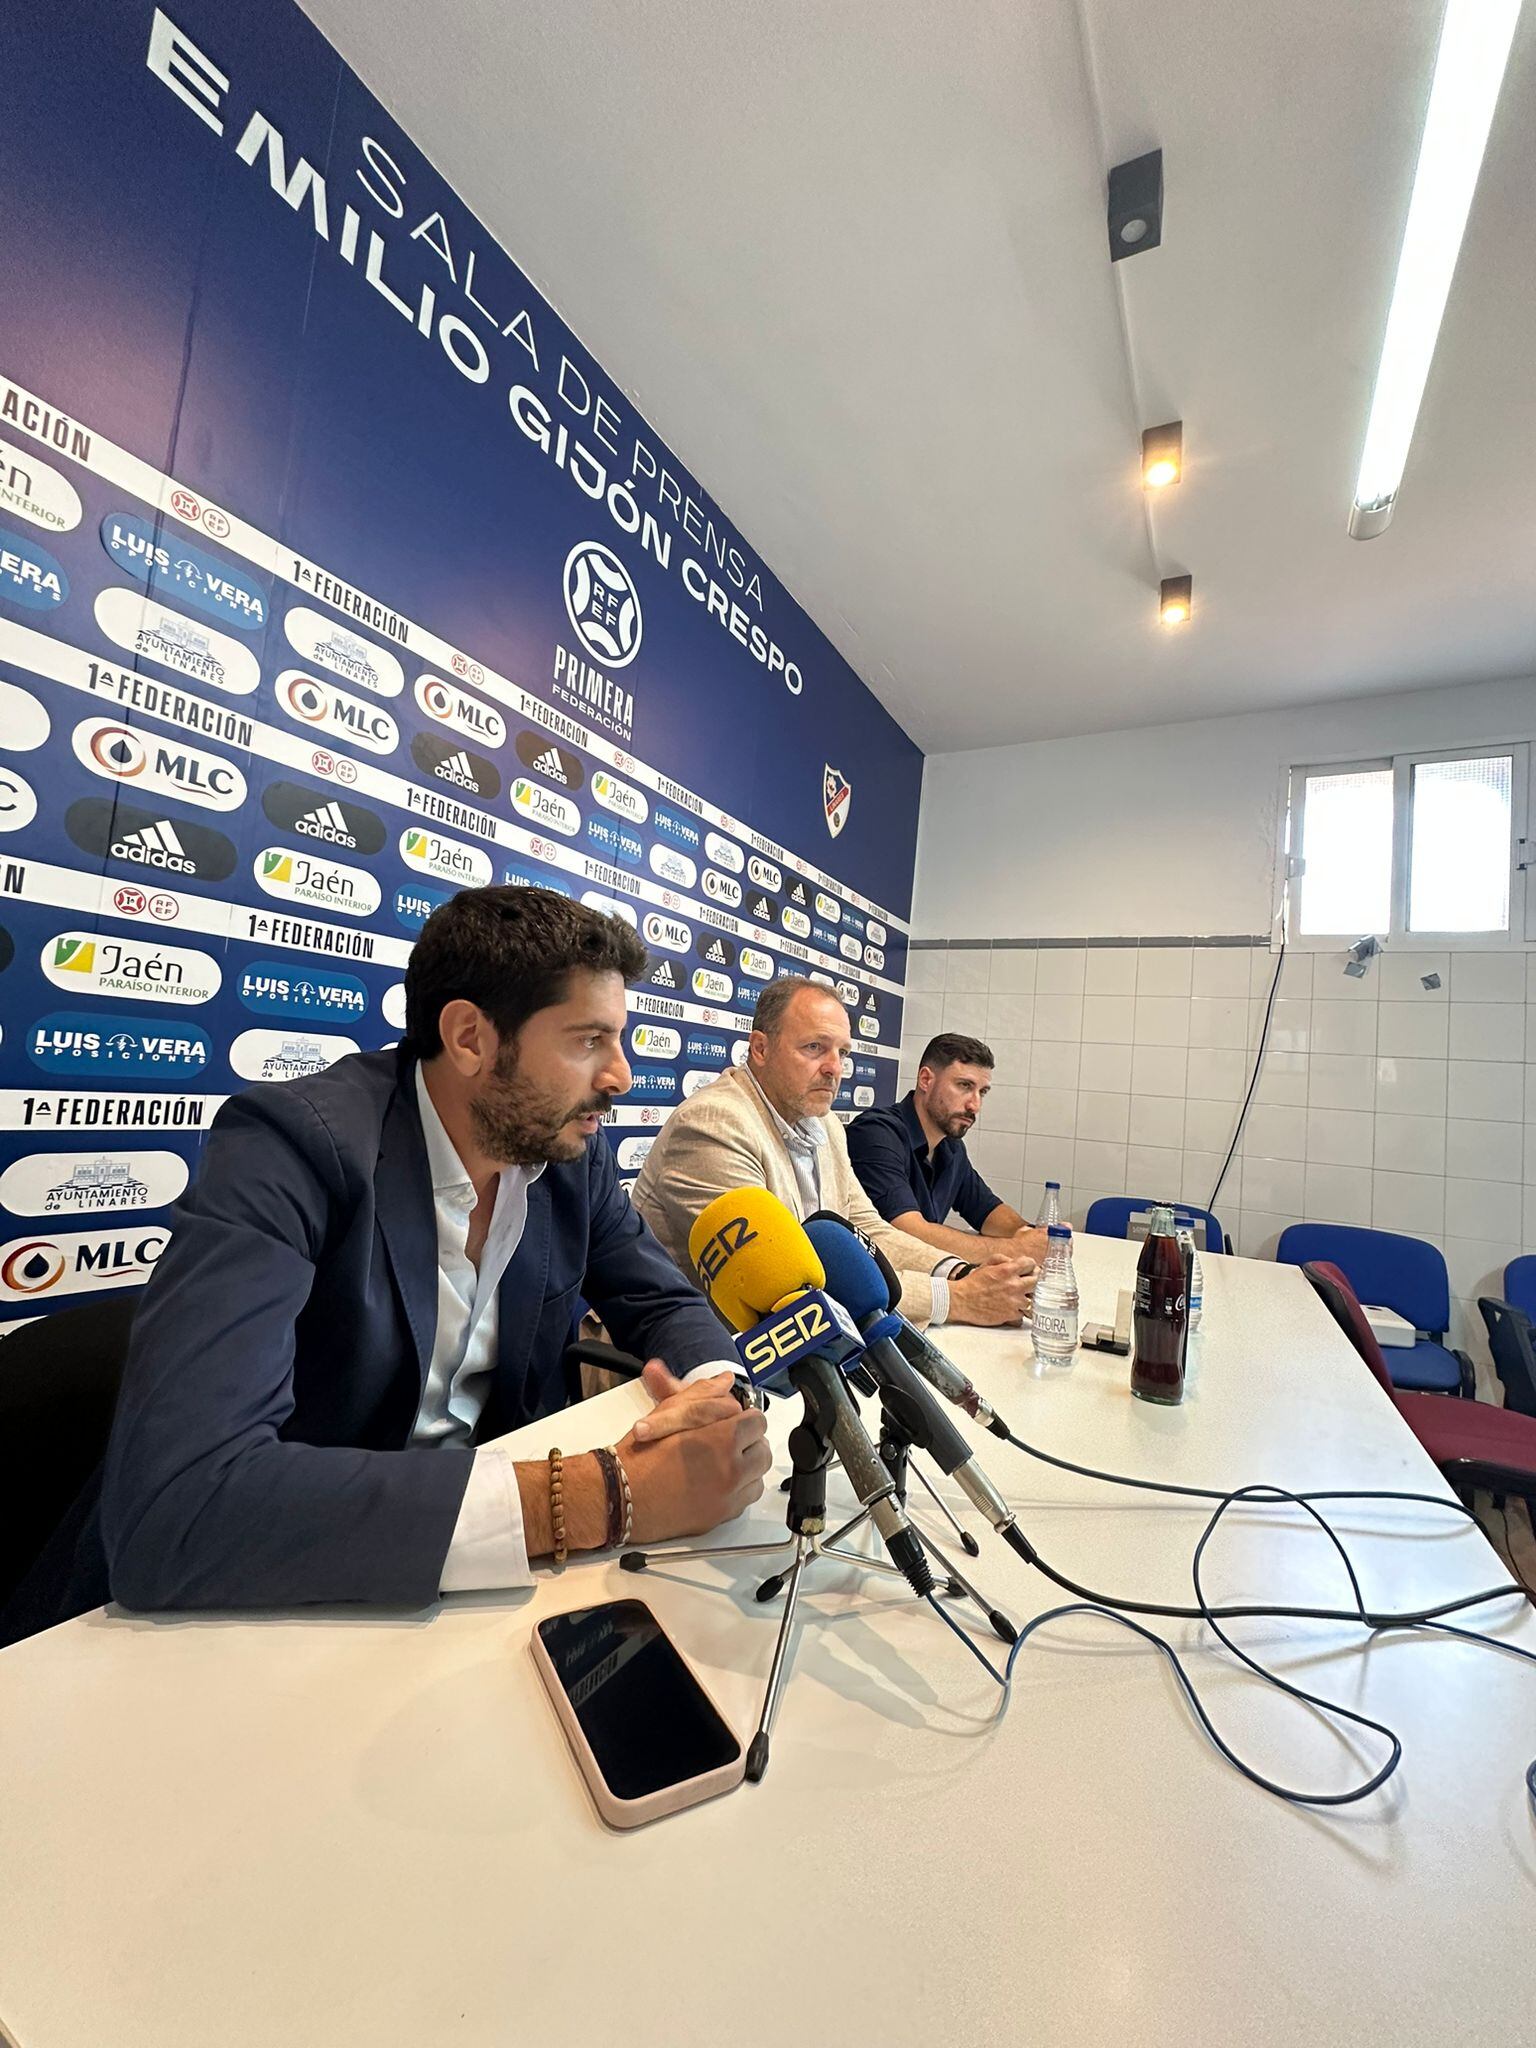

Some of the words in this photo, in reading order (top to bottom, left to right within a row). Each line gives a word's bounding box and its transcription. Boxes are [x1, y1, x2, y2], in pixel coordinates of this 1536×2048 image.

[146, 6, 490, 384] EMILIO
[508, 384, 672, 570] GIJÓN
[681, 558, 803, 696] CRESPO
[355, 136, 540, 372] SALA
[557, 355, 621, 456] DE
[632, 439, 763, 612] PRENSA
[0, 549, 62, 594] ERA
[111, 541, 264, 623] OPOSICIONES
[112, 525, 170, 566] LUIS
[206, 573, 264, 616] VERA
[314, 572, 409, 643] FEDERACIÓN
[135, 643, 148, 653] de
[164, 654, 224, 685] LINARES
[136, 633, 225, 677] AYUNTAMIENTO
[314, 646, 379, 682] AYUNTAMIENTO
[334, 661, 378, 689] LINARES
[553, 644, 634, 728] PRIMERA
[118, 674, 253, 747] FEDERACIÓN
[334, 699, 390, 741] MLC
[457, 700, 499, 736] MLC
[532, 702, 588, 748] FEDERACIÓN
[552, 683, 632, 742] FEDERACIÓN
[155, 748, 235, 795] MLC
[434, 764, 480, 793] adidas
[532, 760, 568, 785] adidas
[533, 789, 566, 821] Jaén
[609, 782, 636, 809] Jaén
[422, 797, 497, 839] FEDERACIÓN
[655, 812, 672, 828] LUIS
[681, 825, 699, 841] VERA
[294, 820, 357, 849] adidas
[588, 821, 609, 839] LUIS
[620, 835, 642, 853] VERA
[111, 843, 196, 874] adidas
[430, 839, 473, 873] Jaén
[295, 860, 354, 897] Jaén
[505, 872, 530, 888] LUIS
[594, 864, 641, 895] FEDERACIÓN
[719, 881, 739, 899] MLC
[763, 867, 779, 884] MLC
[334, 897, 372, 912] INTERIOR
[397, 894, 431, 912] LUIS
[665, 925, 689, 944] MLC
[706, 910, 739, 932] FEDERACIÓN
[271, 919, 374, 959] FEDERACIÓN
[101, 945, 183, 984] Jaén
[705, 951, 726, 965] adidas
[750, 953, 767, 971] Jaén
[99, 977, 153, 993] PARAÍSO
[155, 984, 209, 999] INTERIOR
[243, 975, 290, 994] LUIS
[318, 985, 365, 1005] VERA
[651, 975, 676, 988] adidas
[704, 973, 725, 992] Jaén
[242, 989, 364, 1012] OPOSICIONES
[644, 998, 685, 1019] FEDERACIÓN
[36, 1030, 101, 1050] LUIS
[141, 1038, 206, 1057] VERA
[647, 1030, 671, 1048] Jaén
[687, 1041, 702, 1051] LUIS
[710, 1044, 726, 1054] VERA
[35, 1047, 206, 1064] OPOSICIONES
[262, 1062, 328, 1072] AYUNTAMIENT
[656, 1076, 676, 1086] VERA
[56, 1096, 204, 1125] FEDERACIÓN
[44, 1202, 60, 1211] de
[78, 1196, 147, 1208] LINARES
[46, 1187, 148, 1201] AYUNTAMIENTO
[75, 1238, 164, 1272] MLC
[744, 1303, 832, 1374] SER
